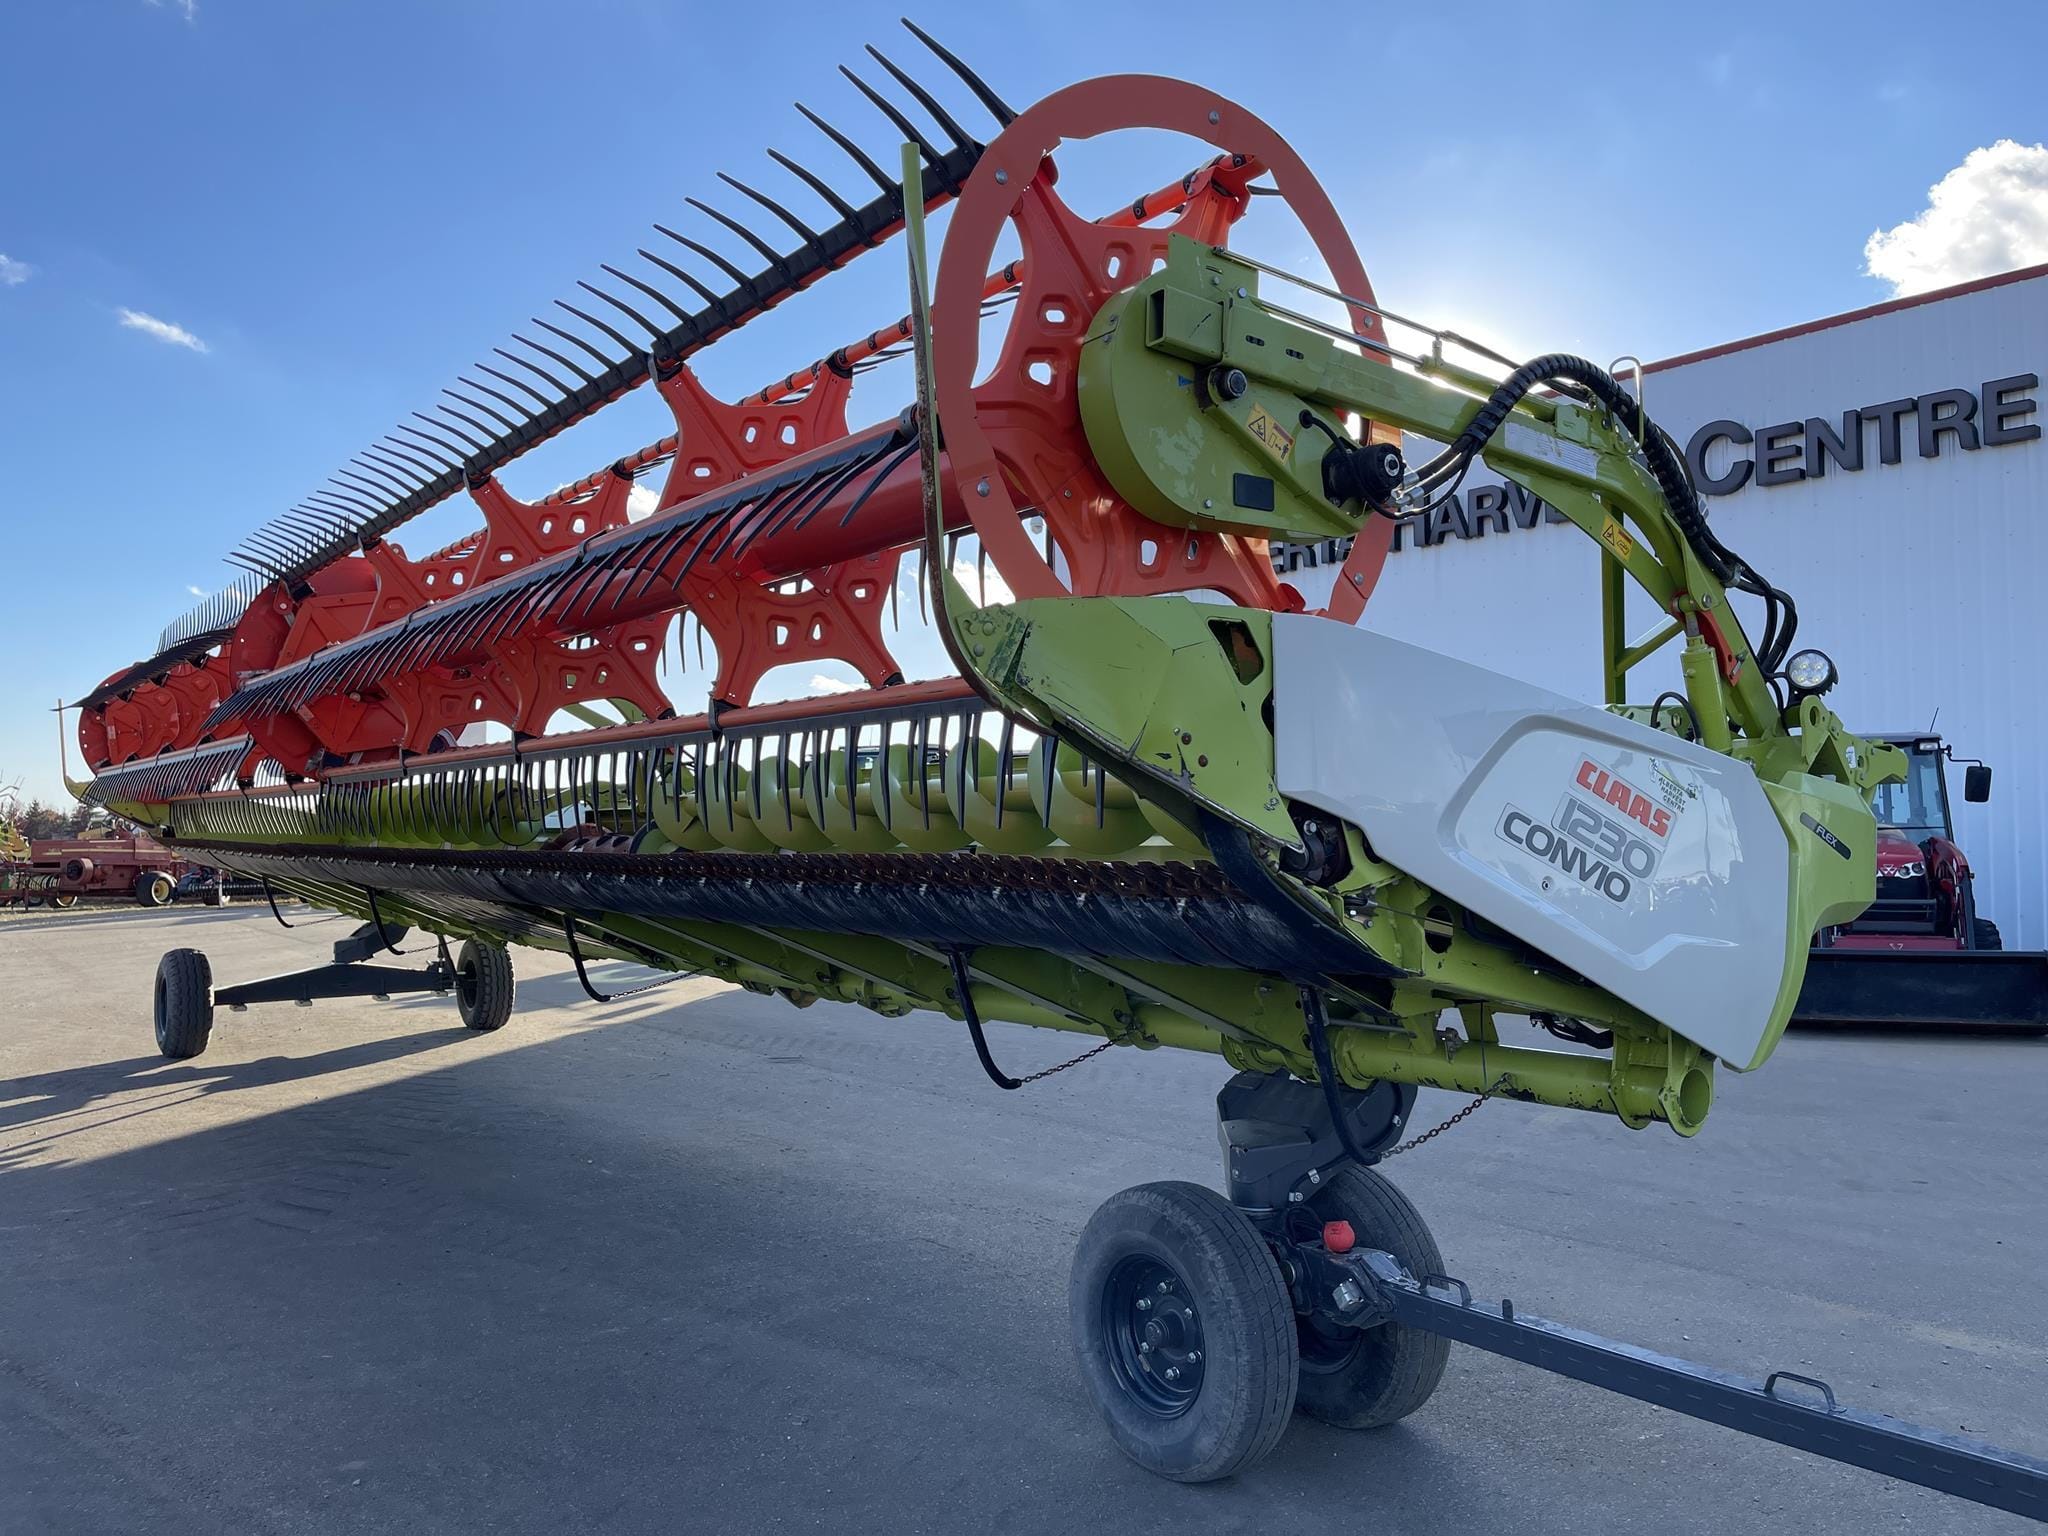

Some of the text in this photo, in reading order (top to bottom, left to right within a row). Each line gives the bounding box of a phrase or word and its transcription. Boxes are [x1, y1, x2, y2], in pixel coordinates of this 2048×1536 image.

[1685, 373, 2042, 496] CENTRE
[1576, 760, 1672, 838] CLAAS
[1658, 776, 1684, 798] ALBERTA
[1660, 785, 1687, 806] HARVEST
[1662, 794, 1686, 814] CENTRE
[1503, 811, 1631, 903] CONVIO
[1558, 798, 1656, 879] 1230
[1816, 825, 1838, 848] FLEX
